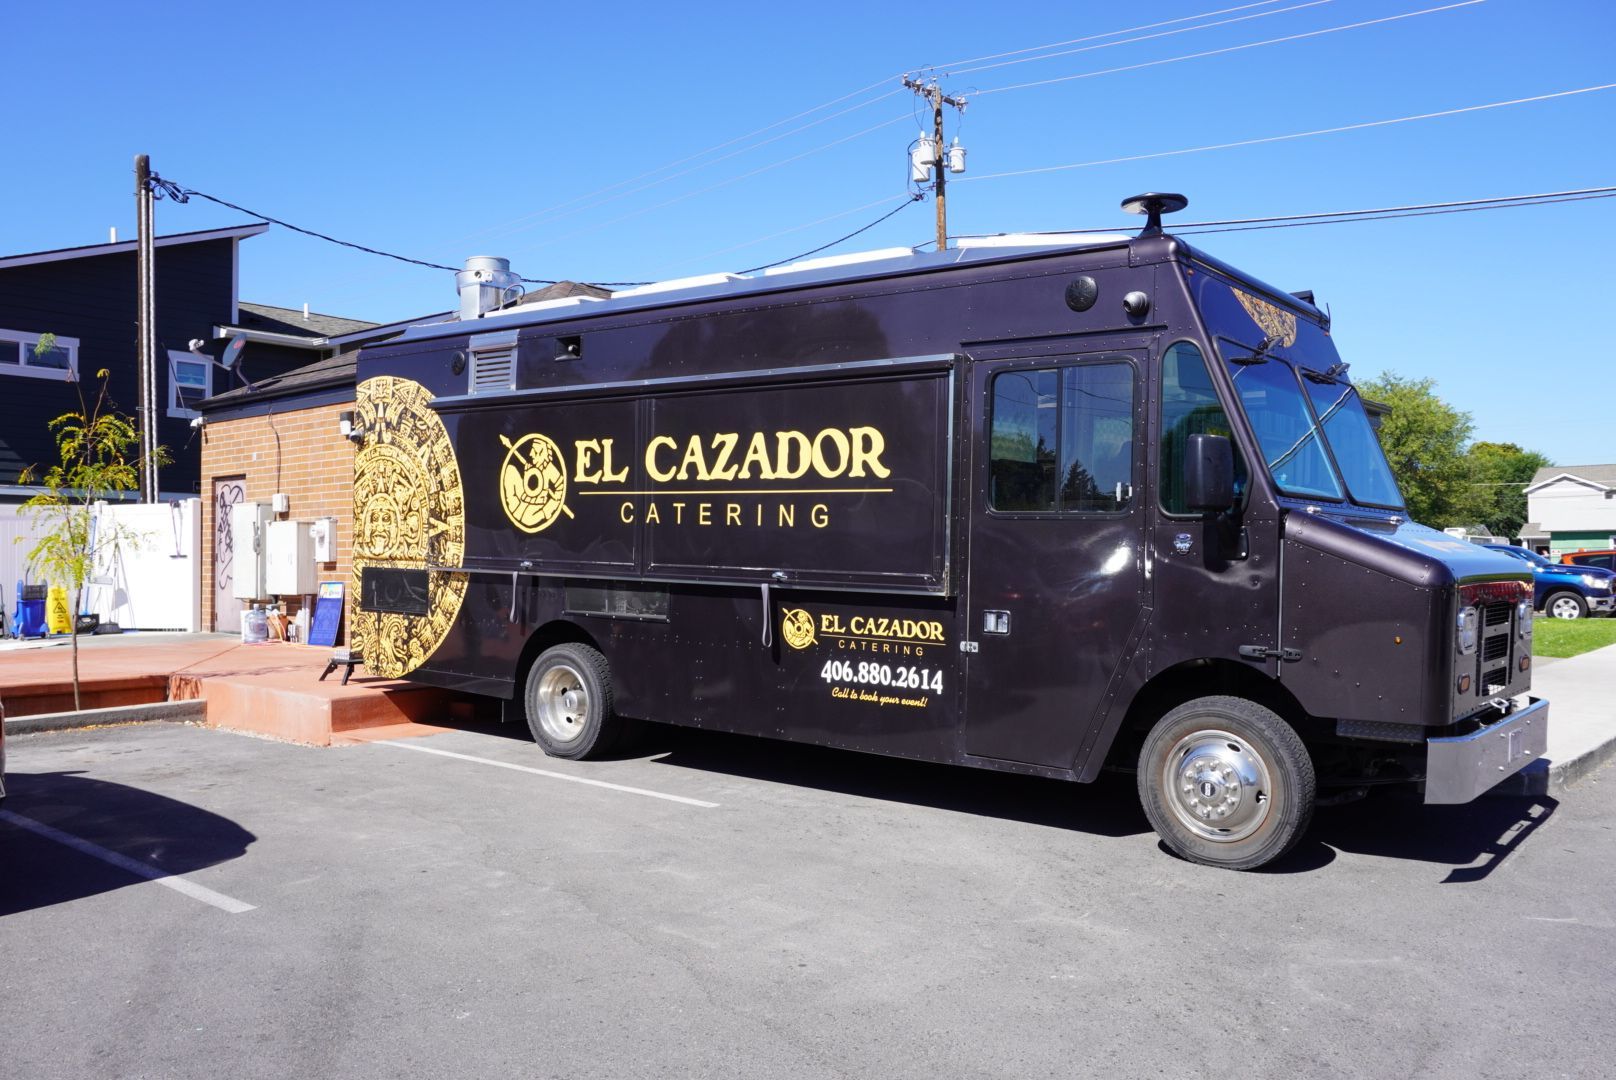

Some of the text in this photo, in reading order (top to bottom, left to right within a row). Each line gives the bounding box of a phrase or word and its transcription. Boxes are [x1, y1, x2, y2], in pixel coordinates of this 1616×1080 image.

[574, 426, 891, 484] EL CAZADOR
[620, 501, 829, 528] CATERING
[821, 614, 945, 641] EL CAZADOR
[838, 639, 924, 656] CATERING
[820, 659, 943, 695] 406.880.2614
[832, 687, 928, 707] Call to book your event!
